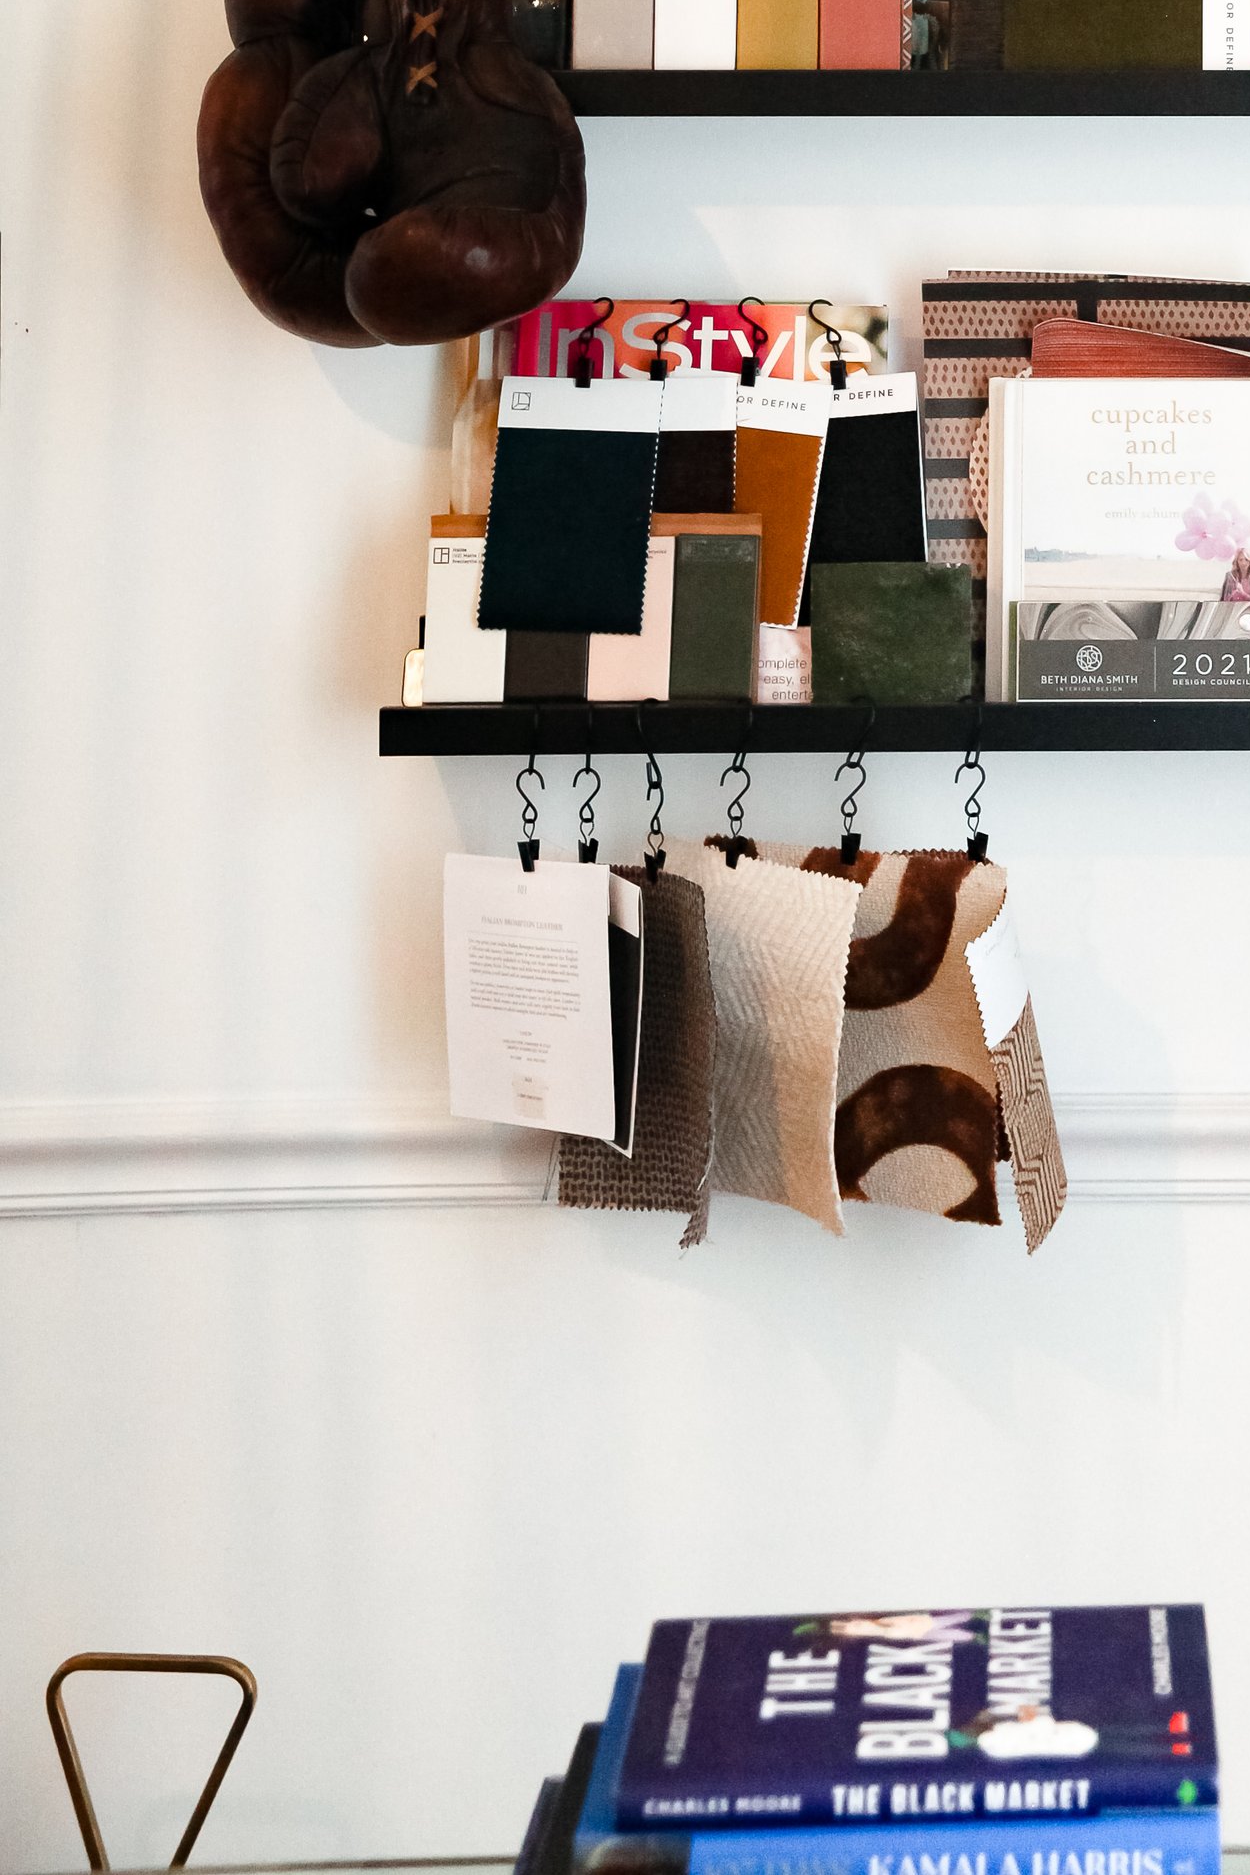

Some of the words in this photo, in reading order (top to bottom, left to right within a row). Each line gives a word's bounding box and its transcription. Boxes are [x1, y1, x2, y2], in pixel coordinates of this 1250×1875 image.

[538, 312, 871, 381] InStyle
[761, 397, 807, 412] DEFINE
[848, 388, 894, 401] DEFINE
[1091, 400, 1213, 433] cupcakes
[1126, 431, 1177, 455] and
[1087, 461, 1217, 486] cashmere
[1172, 653, 1250, 676] 2021
[1041, 676, 1067, 685] BETH
[1070, 676, 1104, 685] DIANA
[1106, 676, 1139, 685] SMITH
[1172, 678, 1206, 686] DESIGN
[1210, 678, 1250, 686] COUNCIL
[987, 1608, 1053, 1719] MARKET
[759, 1648, 842, 1722] THE
[856, 1641, 953, 1761] BLACK
[832, 1783, 880, 1817] THE
[891, 1781, 976, 1815] BLACK
[984, 1778, 1091, 1812] MARKET
